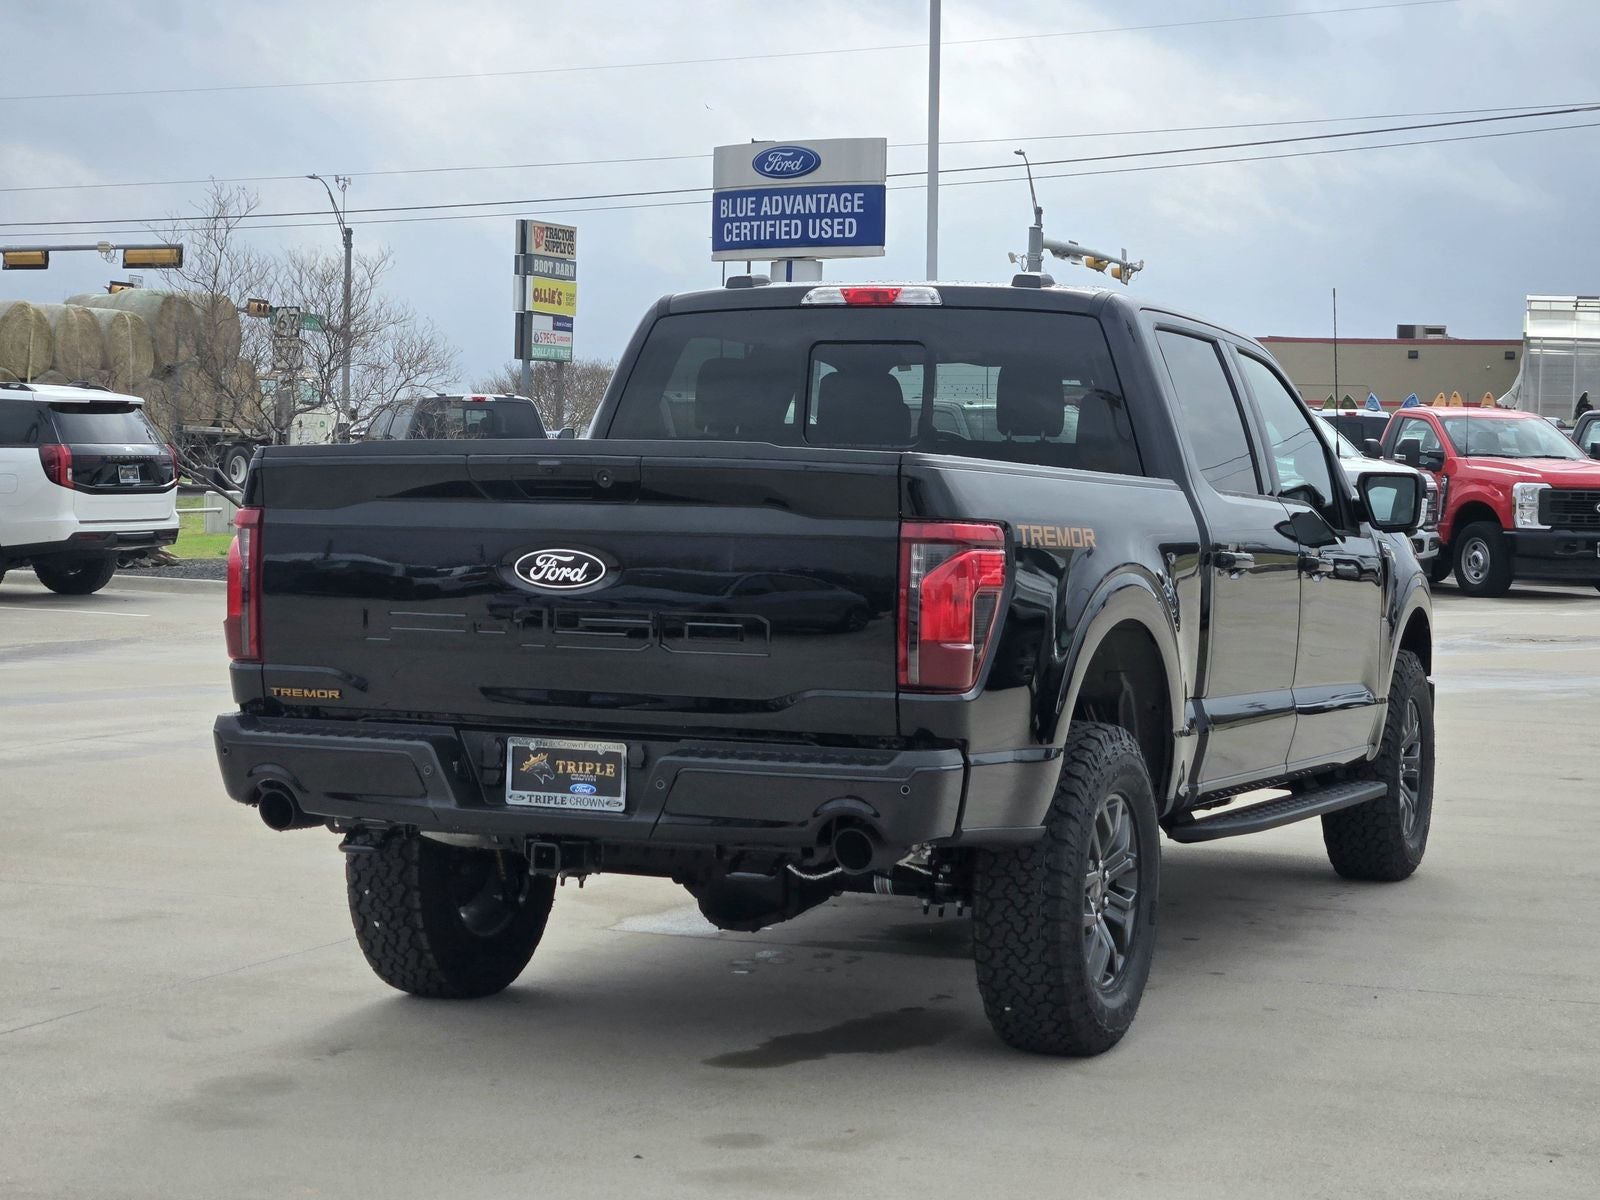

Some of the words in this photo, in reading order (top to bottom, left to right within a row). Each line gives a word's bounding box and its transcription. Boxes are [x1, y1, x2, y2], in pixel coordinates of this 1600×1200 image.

[764, 151, 804, 172] Ford
[720, 197, 756, 218] BLUE
[760, 192, 865, 216] ADVANTAGE
[545, 227, 575, 242] TRACTOR
[723, 219, 802, 243] CERTIFIED
[808, 218, 857, 239] USED
[544, 239, 567, 254] SUPPLY
[534, 259, 554, 274] BOOT
[555, 262, 575, 277] BARN
[533, 288, 562, 305] OLLIE'S
[276, 313, 298, 331] 67
[1016, 524, 1097, 548] TREMOR
[529, 553, 590, 582] Ford
[270, 686, 341, 699] TREMOR
[555, 760, 616, 777] TRIPLE
[527, 793, 567, 805] TRIPLE
[569, 796, 605, 808] CROWN
